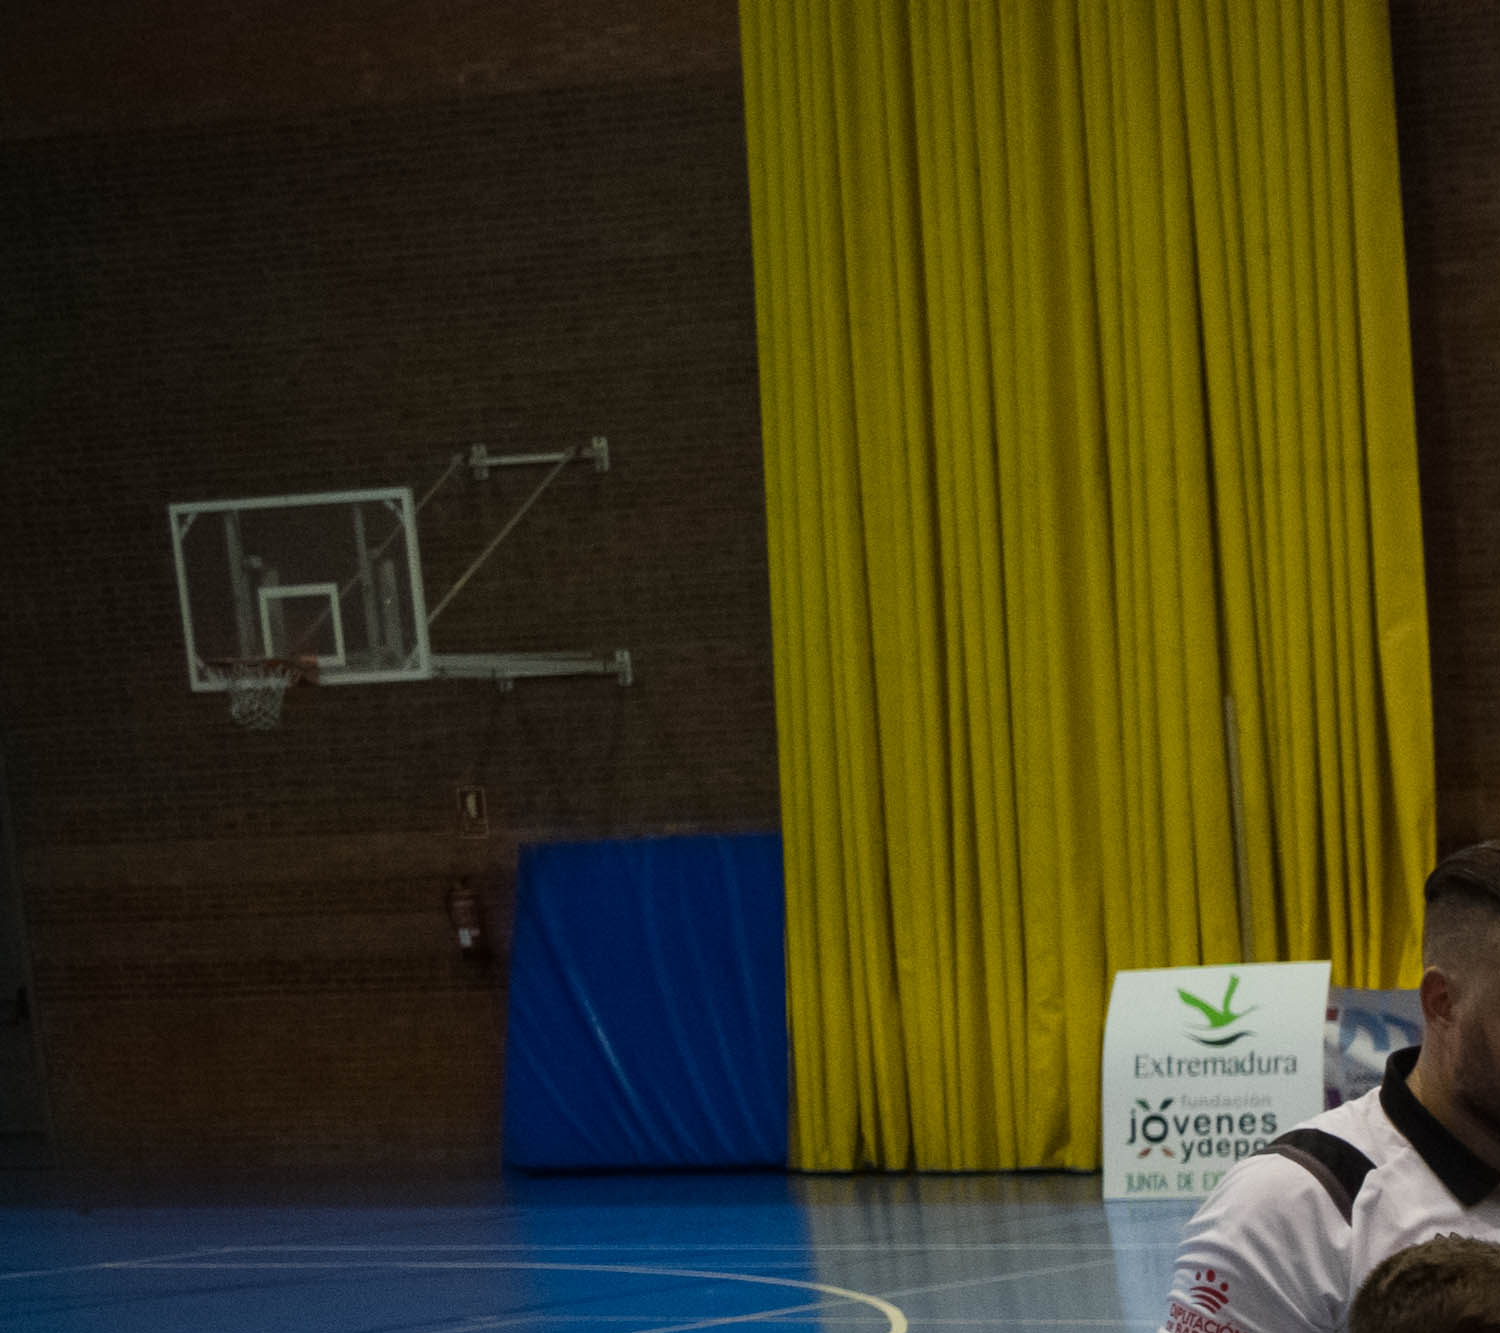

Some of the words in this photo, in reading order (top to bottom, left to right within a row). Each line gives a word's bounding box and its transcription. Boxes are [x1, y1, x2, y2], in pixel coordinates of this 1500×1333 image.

[1134, 1050, 1297, 1079] Extremadura
[1181, 1139, 1269, 1163] ydepo
[1126, 1174, 1168, 1193] JUNTA
[1177, 1173, 1193, 1191] DE
